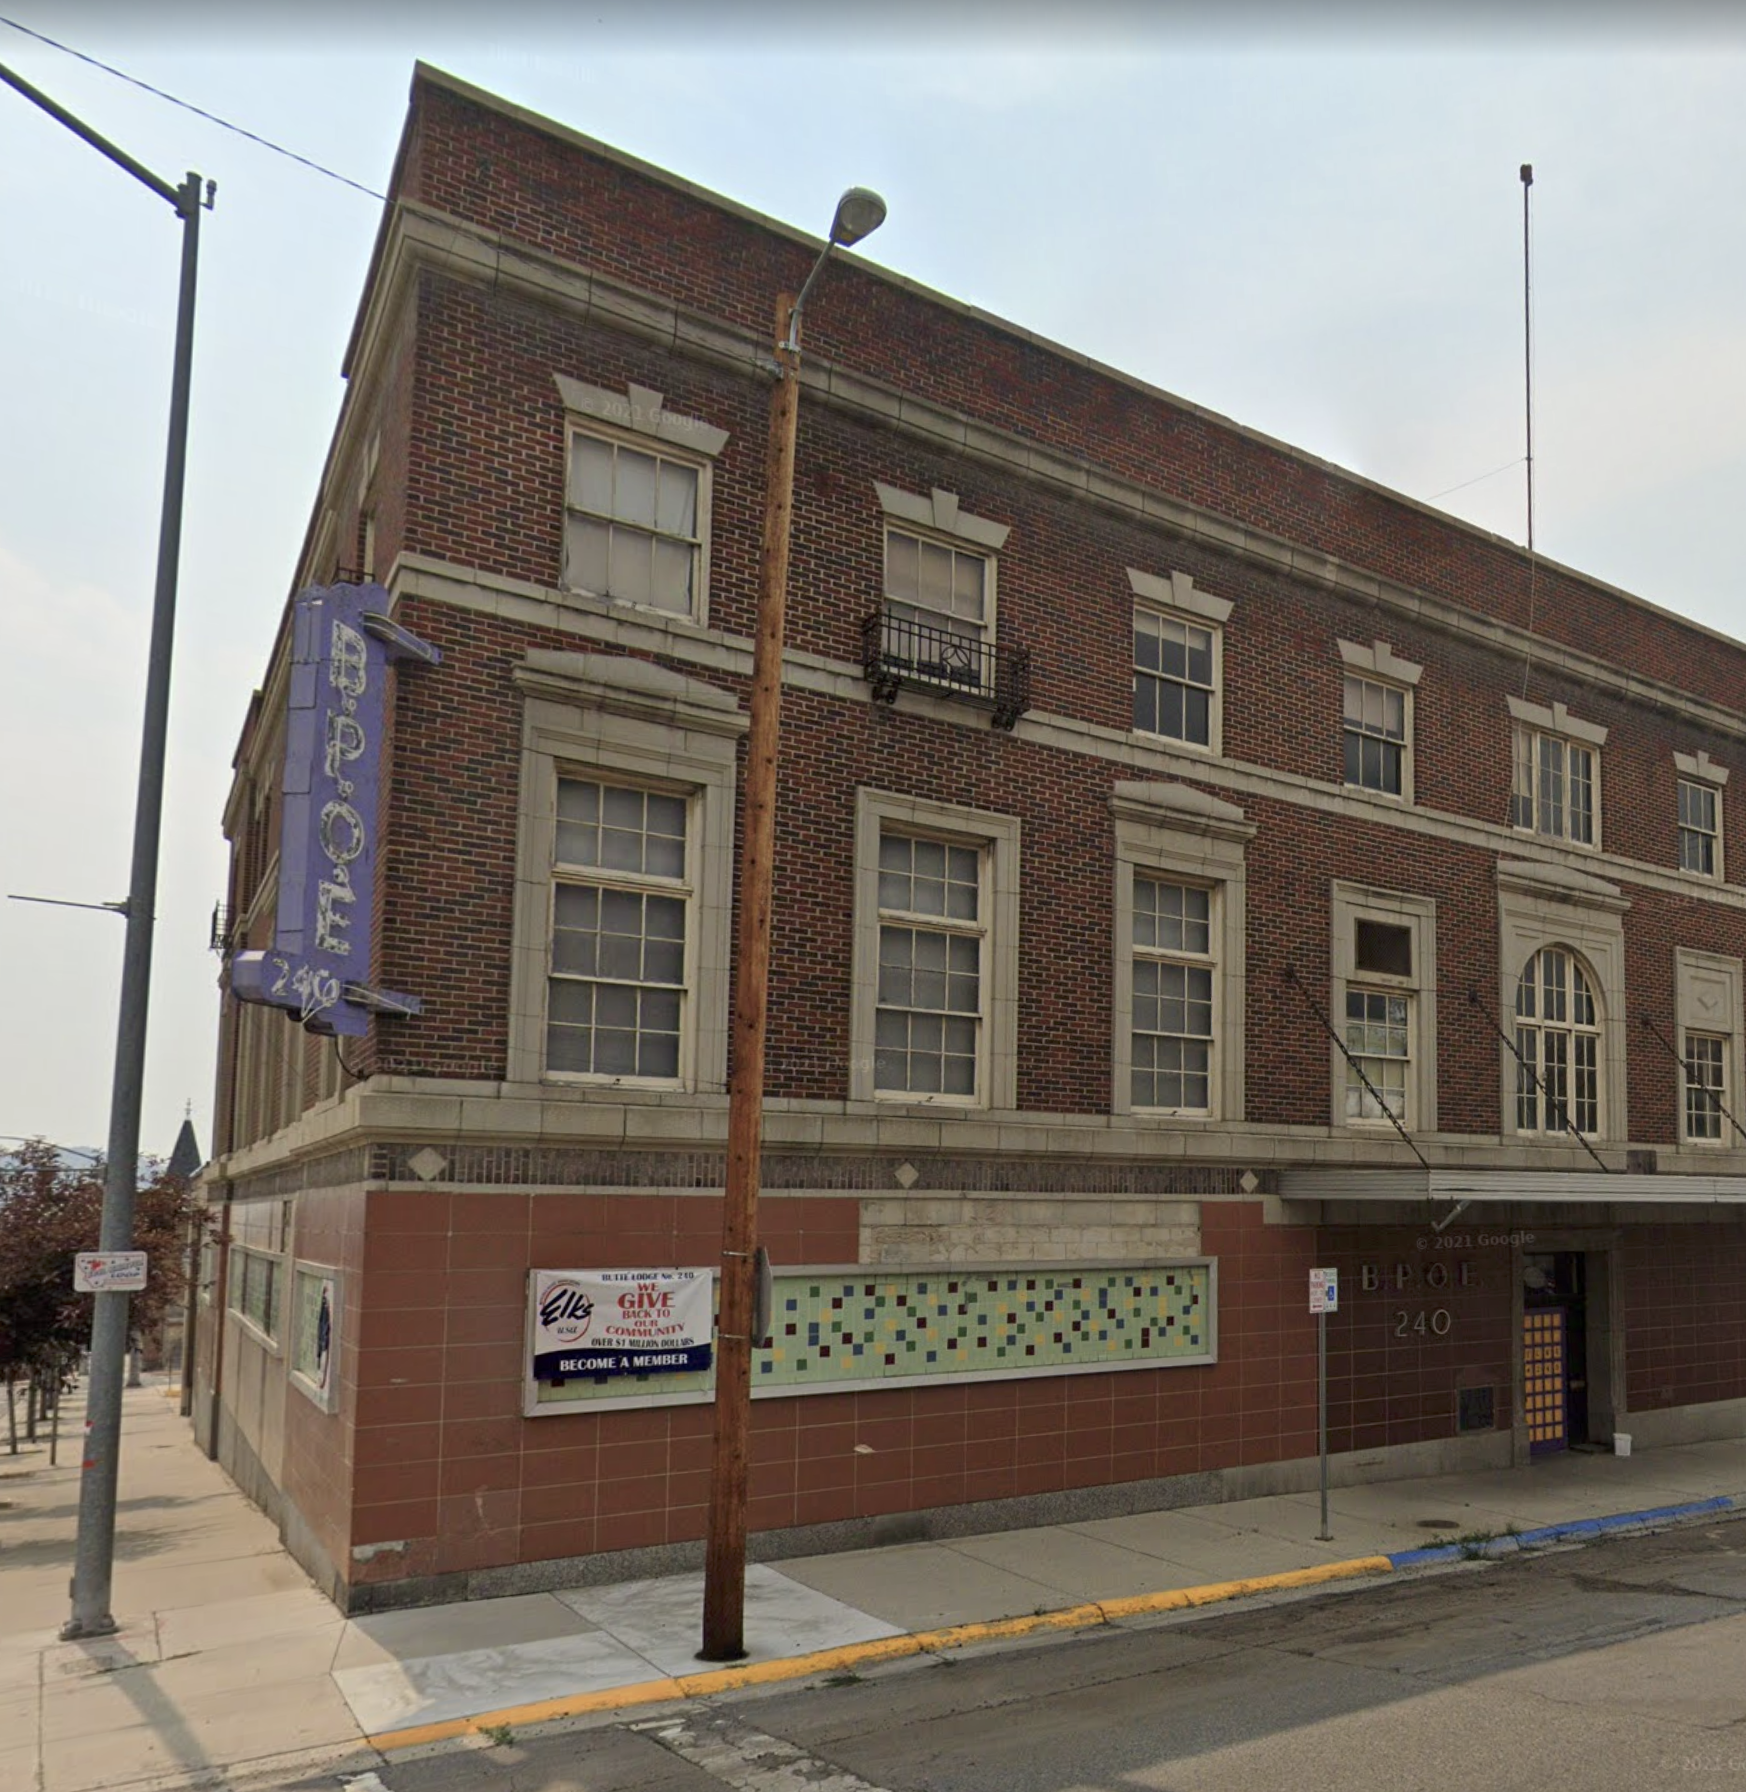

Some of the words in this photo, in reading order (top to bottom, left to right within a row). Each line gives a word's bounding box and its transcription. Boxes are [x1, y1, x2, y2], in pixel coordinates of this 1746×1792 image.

[677, 1271, 694, 1279] 240
[637, 1282, 659, 1291] WE
[617, 1291, 676, 1309] GIVE
[540, 1288, 595, 1326] Elks
[621, 1310, 652, 1319] BACK
[656, 1309, 671, 1318] TO
[634, 1320, 658, 1328] OUR
[1394, 1308, 1452, 1338] 240
[605, 1322, 685, 1337] COMMUNITY
[591, 1338, 613, 1346] OVER
[661, 1337, 695, 1347] DOLLARS
[560, 1357, 617, 1372] BECOME
[619, 1356, 630, 1368] A
[632, 1353, 689, 1368] MEMBER
